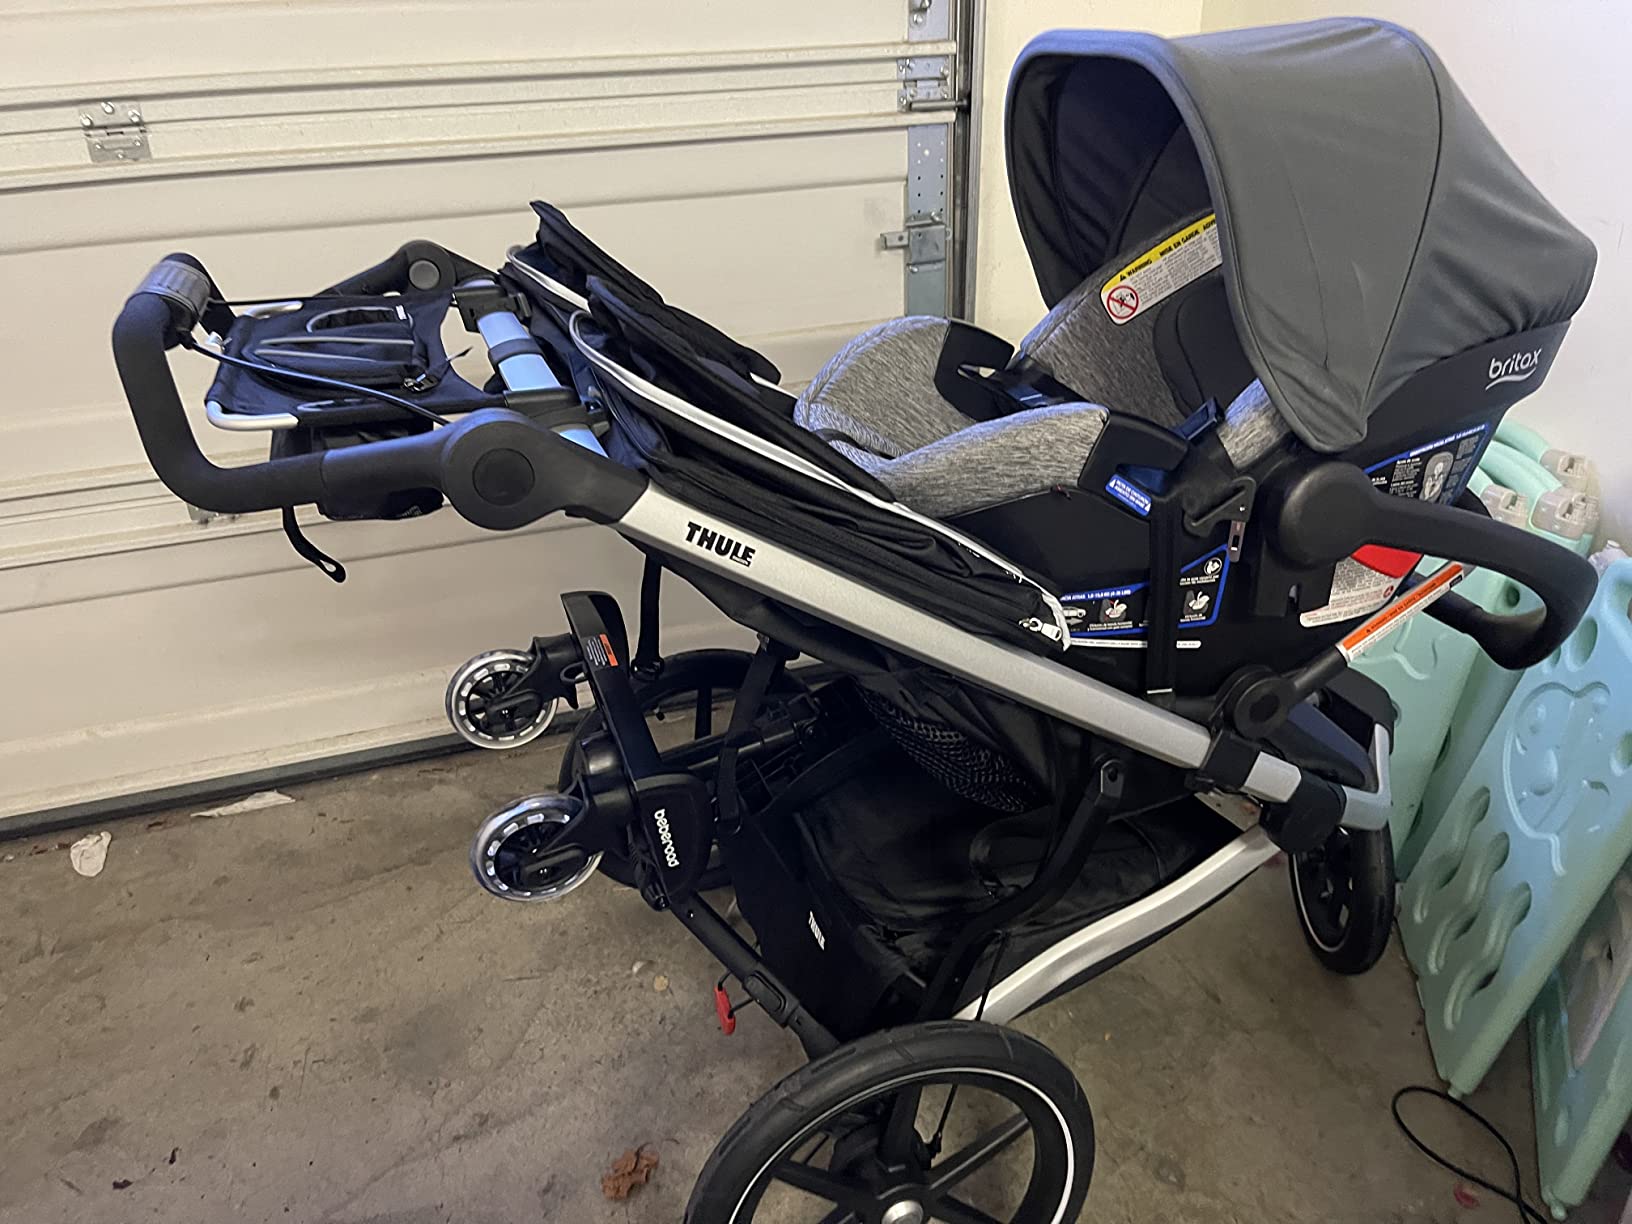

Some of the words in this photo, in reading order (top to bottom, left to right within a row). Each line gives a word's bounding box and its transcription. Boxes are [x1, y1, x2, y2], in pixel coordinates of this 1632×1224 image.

[1127, 259, 1153, 277] WARNING
[1488, 348, 1542, 379] britax
[685, 520, 756, 568] THULE
